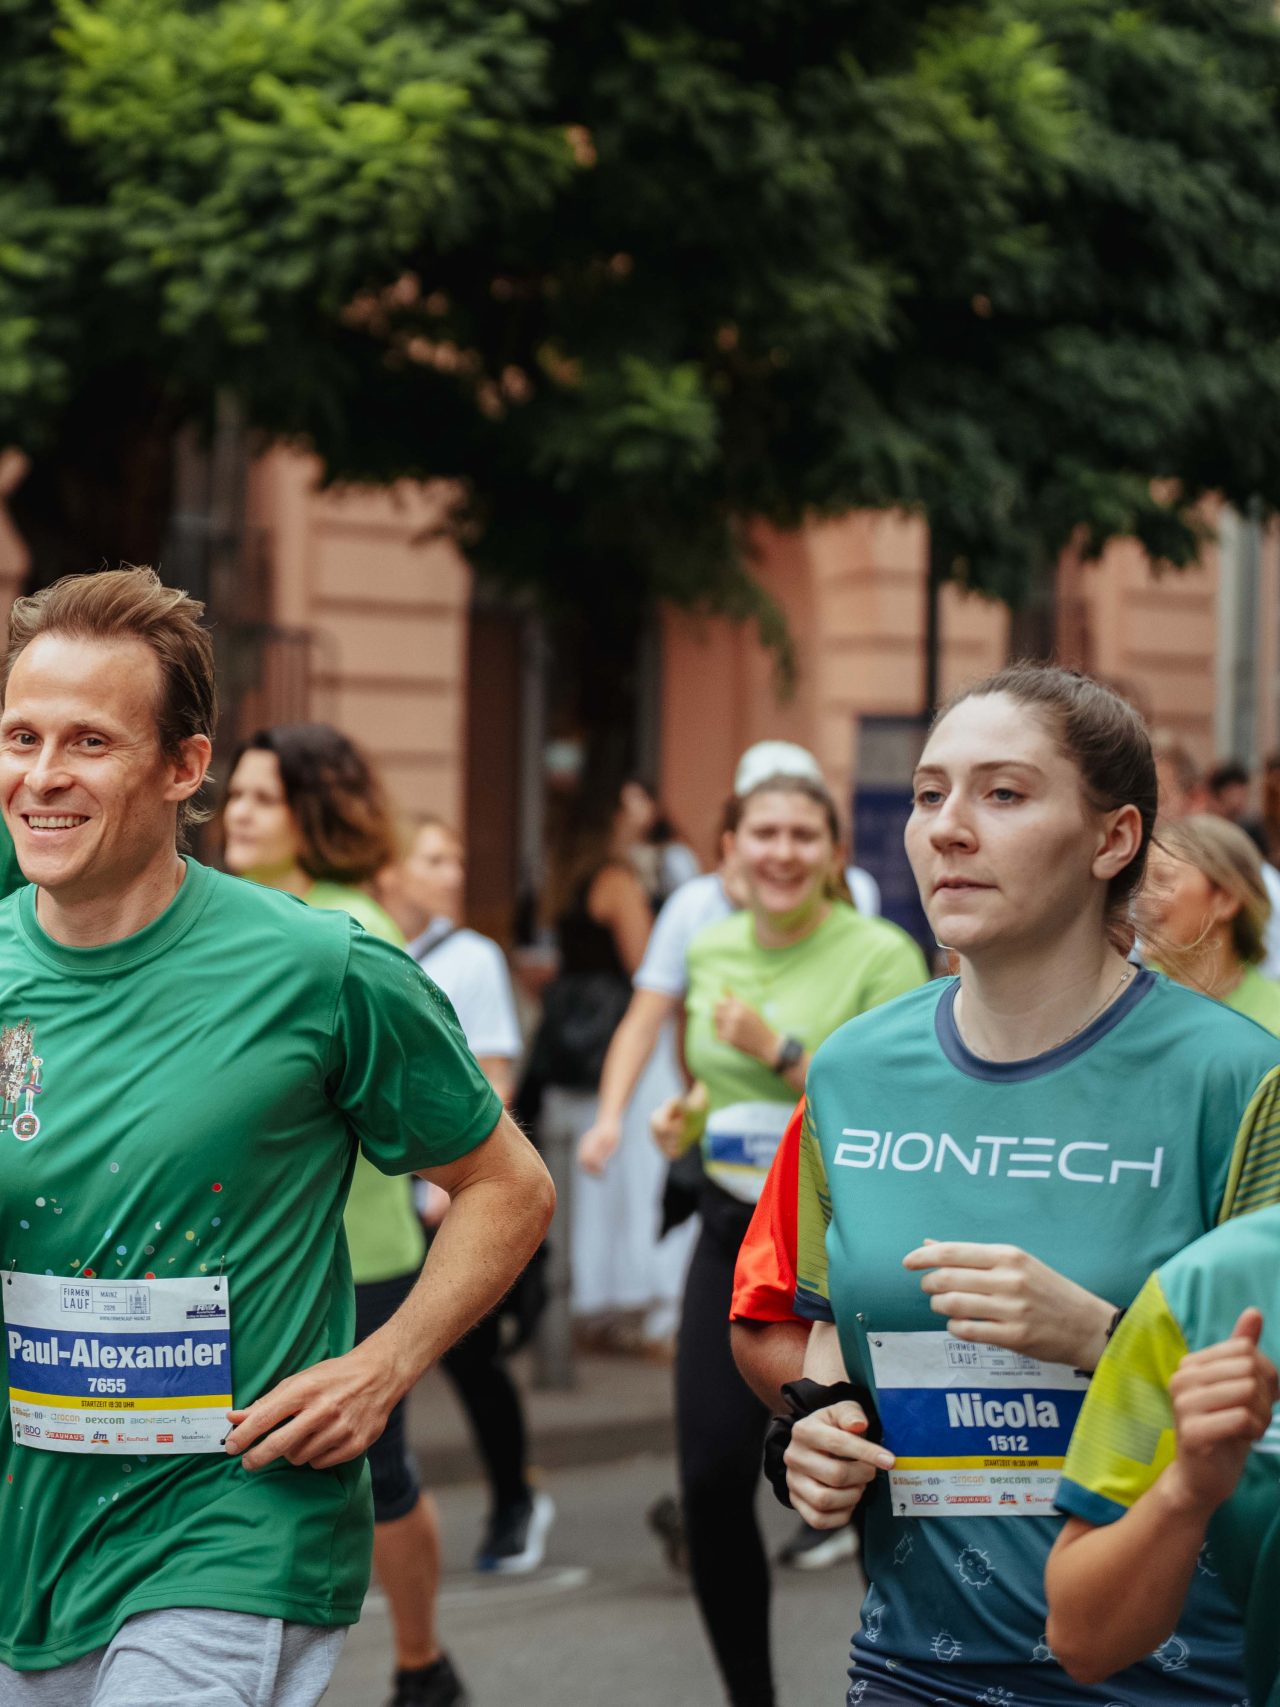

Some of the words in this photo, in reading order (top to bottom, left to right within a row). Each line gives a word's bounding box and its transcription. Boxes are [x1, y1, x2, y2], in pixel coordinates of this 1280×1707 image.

[832, 1127, 1164, 1188] BIONTECH
[63, 1287, 90, 1297] FIRMEN
[63, 1297, 90, 1310] LAUF
[7, 1330, 227, 1369] Paul-Alexander
[950, 1353, 977, 1365] LAUF
[87, 1377, 127, 1394] 7655
[81, 1400, 107, 1408] STARTZEIT
[123, 1401, 135, 1409] UHR
[945, 1392, 1060, 1429] Nicola
[130, 1416, 177, 1425] BIONTECH
[24, 1425, 41, 1435] BDO
[51, 1432, 85, 1441] BAUHAUS
[93, 1431, 108, 1440] dm
[987, 1435, 1030, 1452] 1512
[1000, 1491, 1015, 1501] dm
